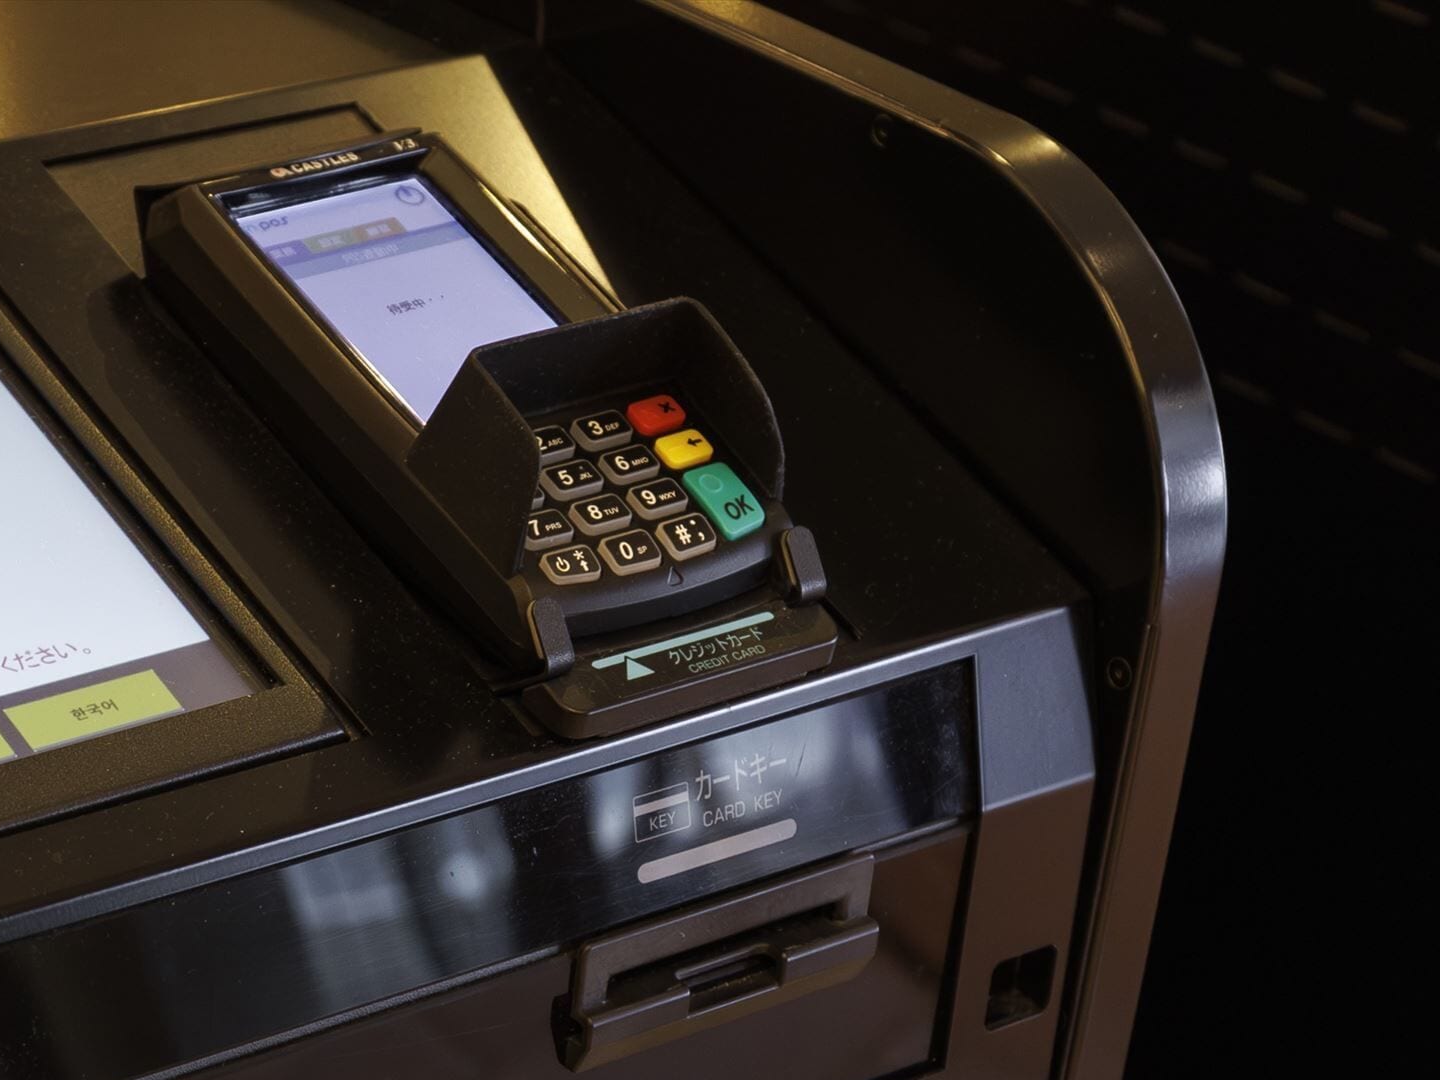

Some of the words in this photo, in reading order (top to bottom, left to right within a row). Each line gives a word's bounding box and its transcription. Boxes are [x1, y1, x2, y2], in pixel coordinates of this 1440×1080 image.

[290, 151, 359, 174] CASTLES
[588, 420, 603, 435] 3
[615, 455, 630, 471] 6
[558, 469, 574, 485] 5
[641, 490, 657, 505] 9
[659, 490, 676, 501] WXY
[723, 494, 755, 521] OK
[586, 504, 603, 520] 8
[603, 506, 619, 517] TUV
[528, 519, 541, 536] 7
[619, 541, 634, 560] 0
[669, 627, 763, 665] クレジットカード
[688, 655, 730, 674] CREDIT
[732, 644, 767, 662] CARD
[70, 698, 119, 721] 한국어
[696, 753, 787, 801] カードキー
[702, 801, 746, 827] CARD
[754, 789, 783, 812] KEY
[650, 811, 677, 832] KEY
